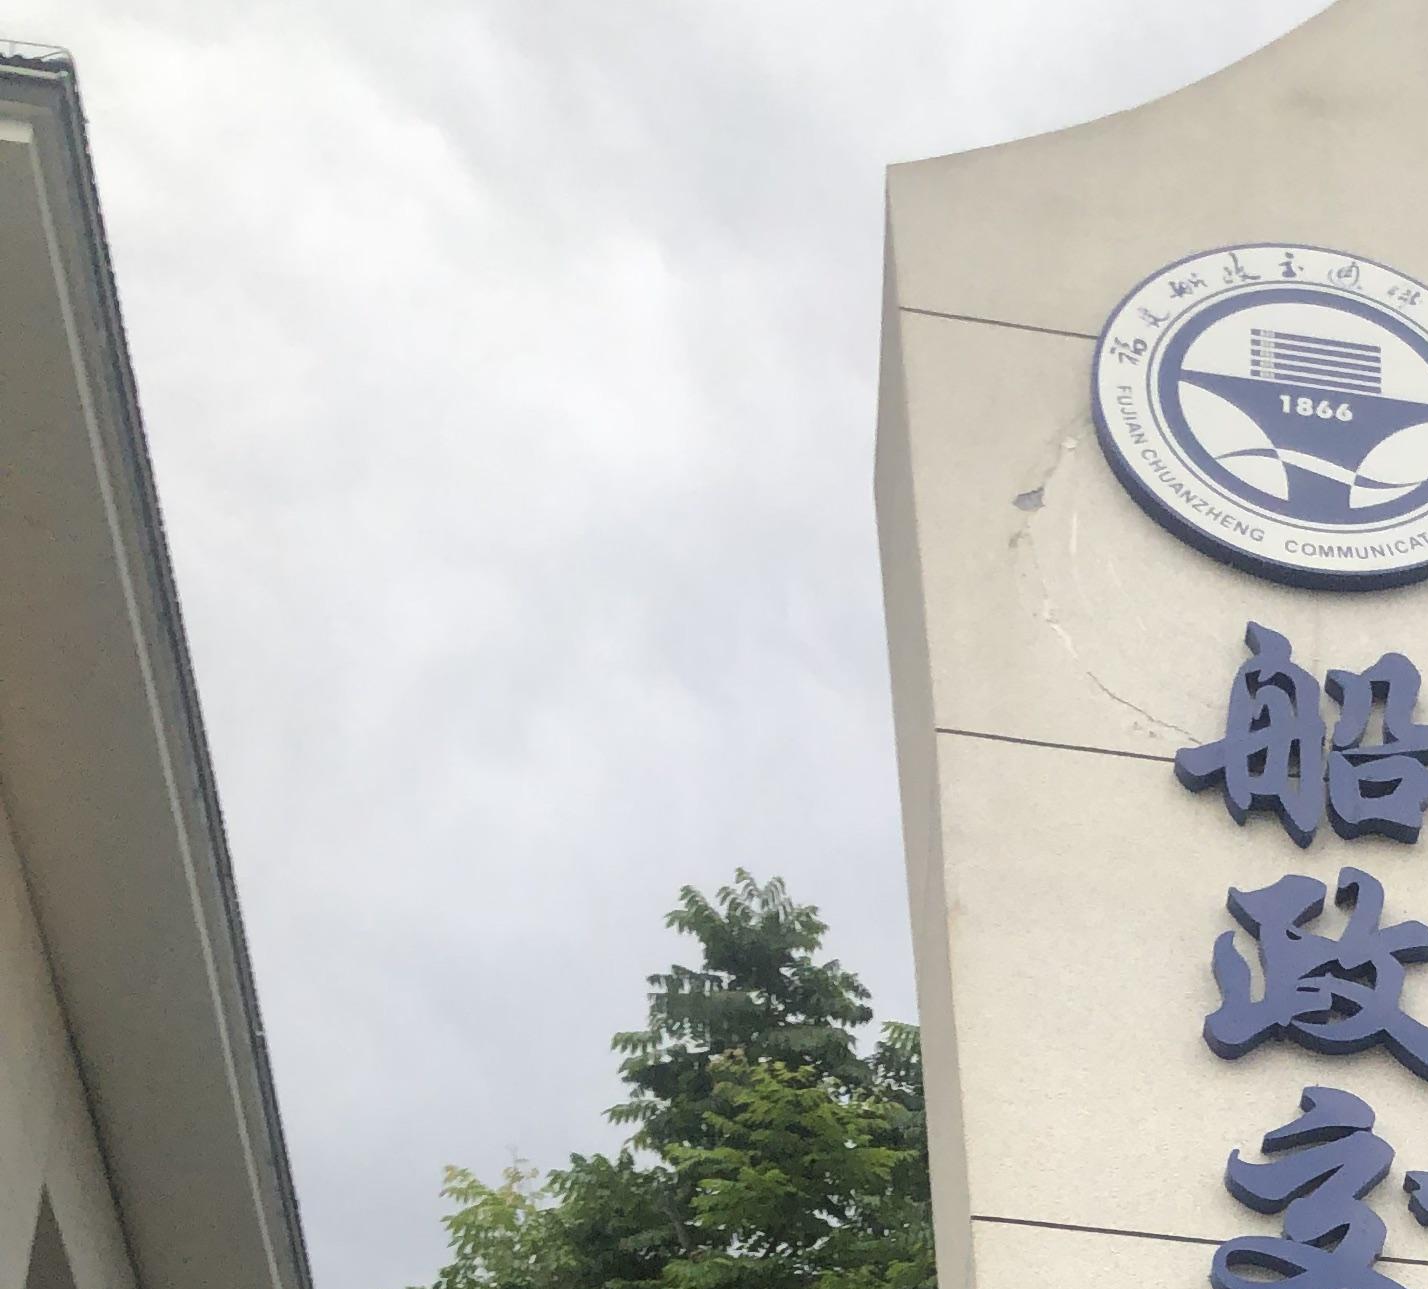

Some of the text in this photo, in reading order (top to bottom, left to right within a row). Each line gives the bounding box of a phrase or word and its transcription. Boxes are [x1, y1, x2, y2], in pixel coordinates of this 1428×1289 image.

[1279, 394, 1354, 422] 1866
[1117, 384, 1149, 447] FUJIAN
[1140, 449, 1266, 543] CHUANZHENG
